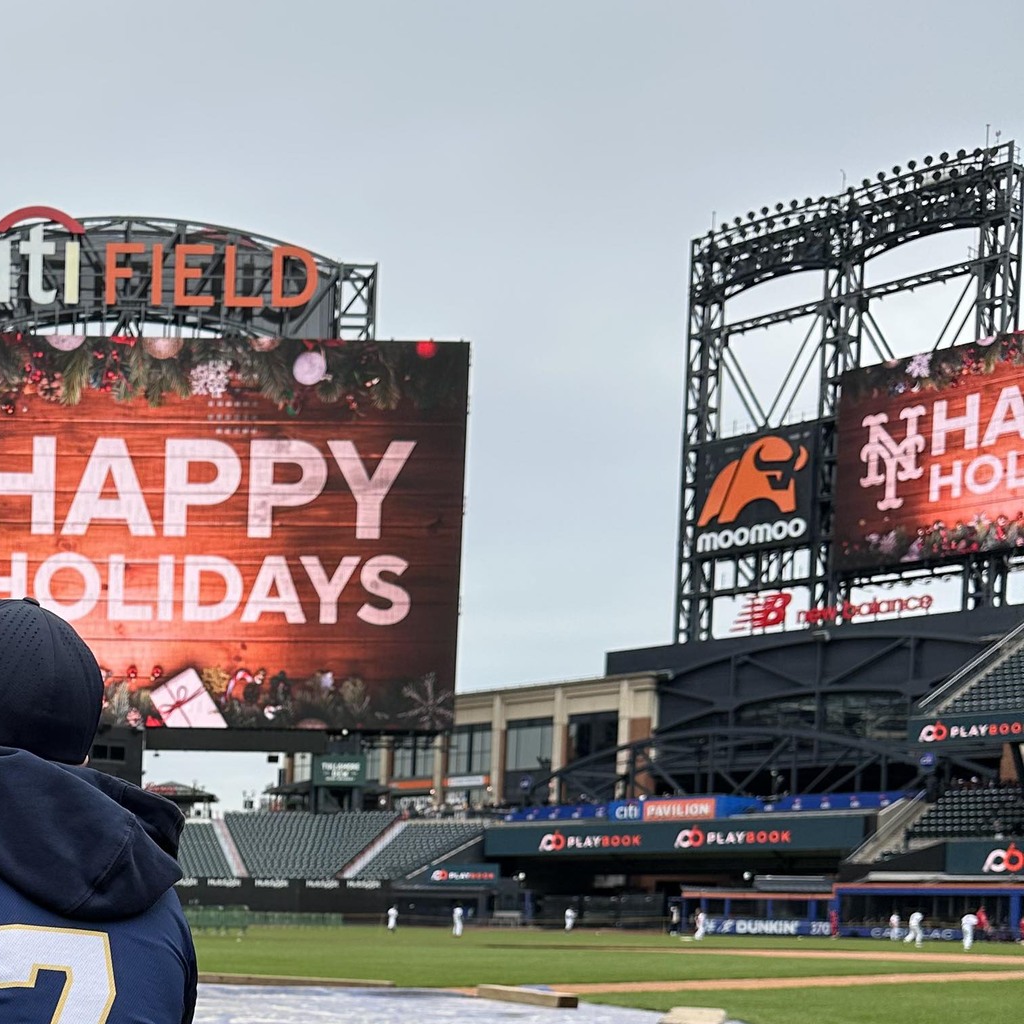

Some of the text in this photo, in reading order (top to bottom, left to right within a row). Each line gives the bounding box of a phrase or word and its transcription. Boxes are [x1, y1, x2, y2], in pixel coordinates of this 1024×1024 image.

[104, 242, 319, 308] FIELD
[696, 517, 807, 553] moomoo
[647, 803, 710, 818] PAVILION
[567, 834, 642, 848] PLAYBOOK
[706, 830, 792, 845] PLAYBOOK
[810, 921, 831, 936] 370
